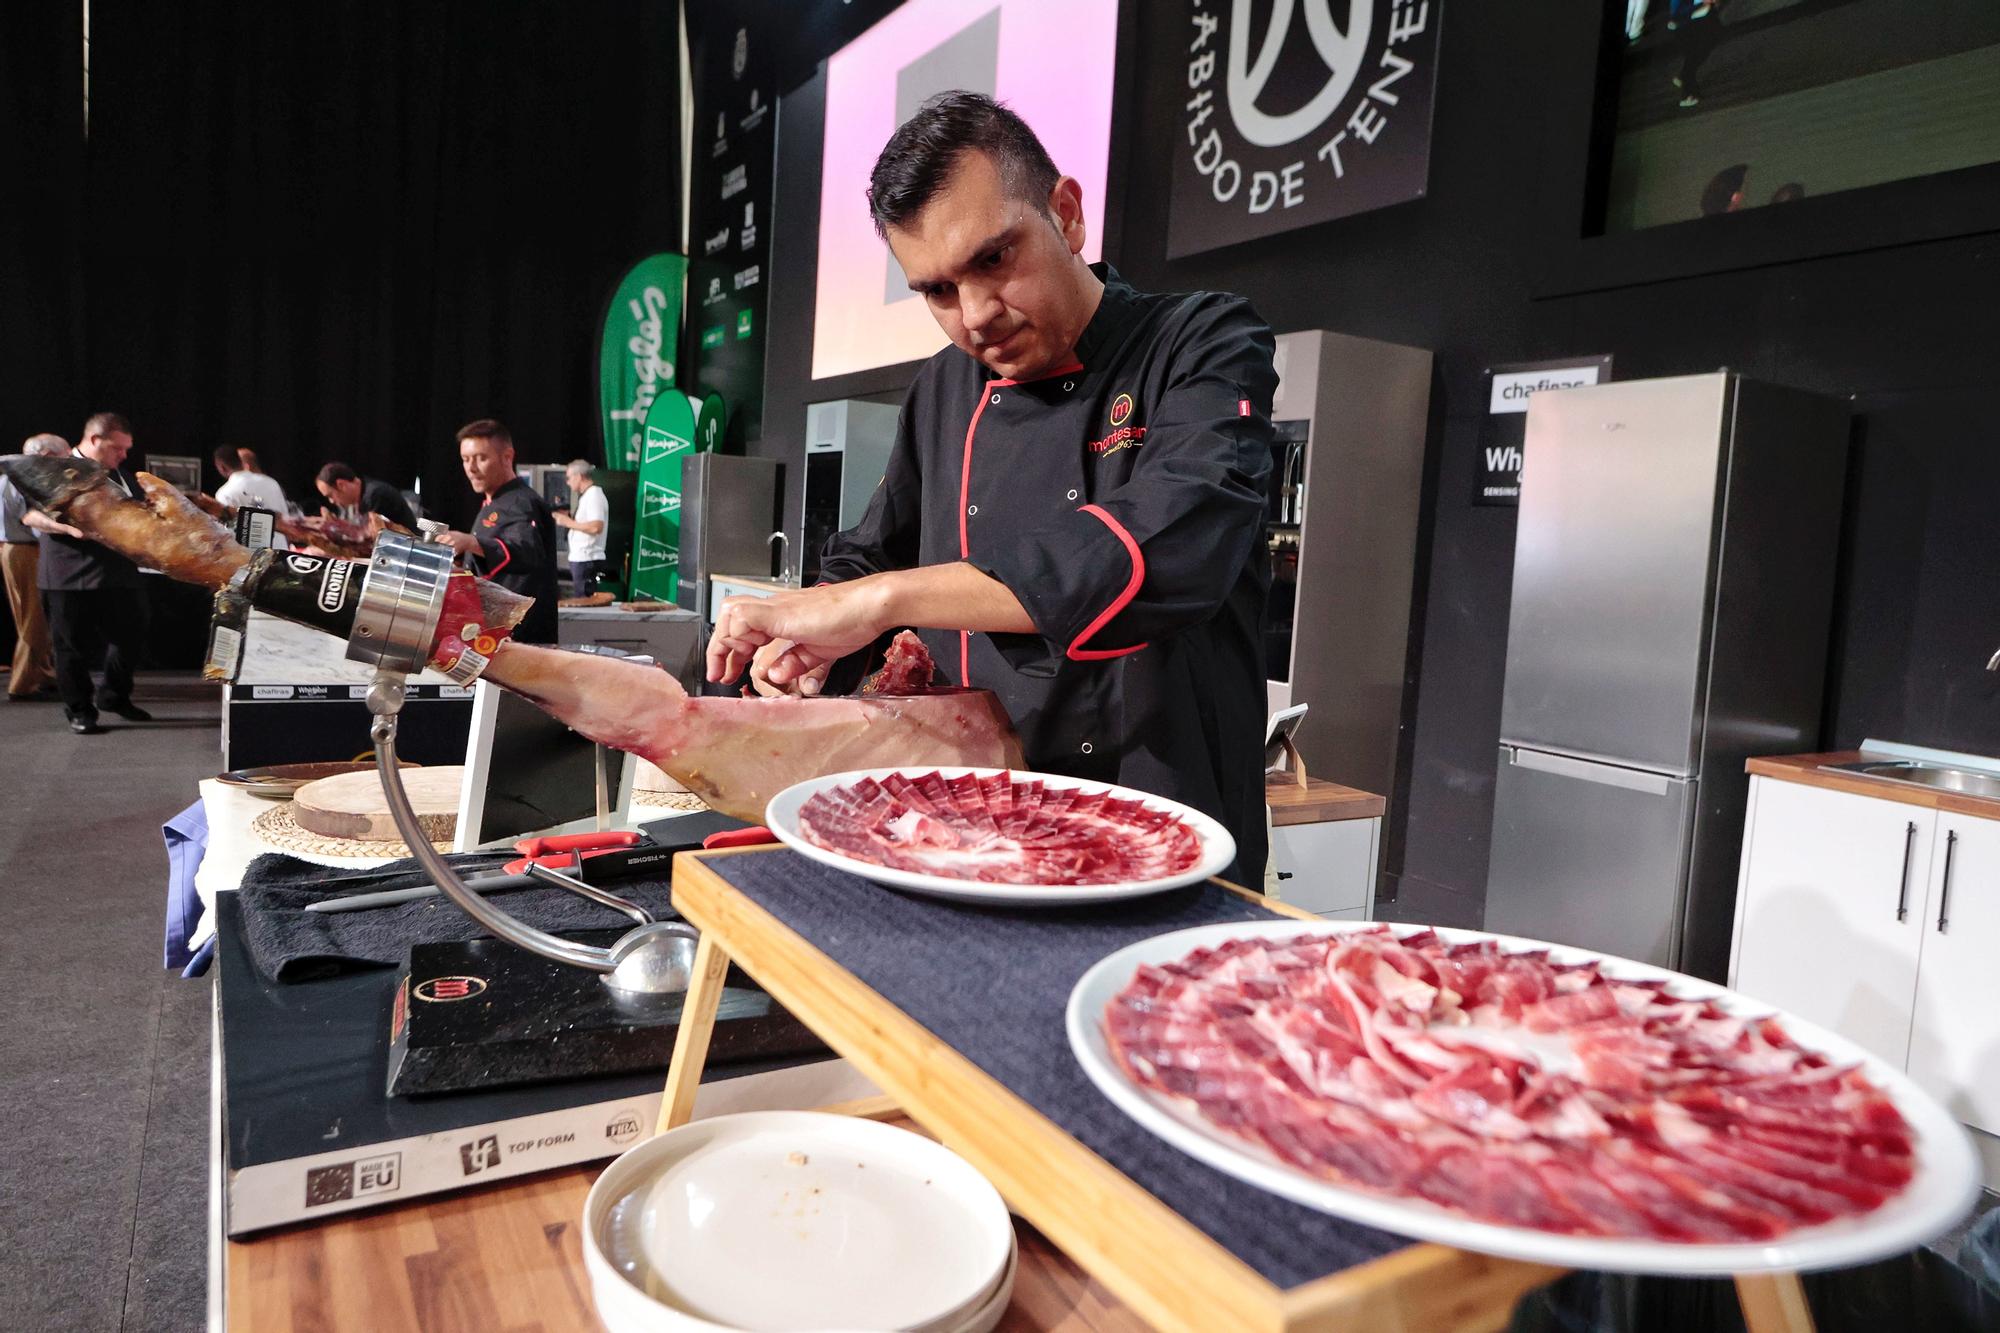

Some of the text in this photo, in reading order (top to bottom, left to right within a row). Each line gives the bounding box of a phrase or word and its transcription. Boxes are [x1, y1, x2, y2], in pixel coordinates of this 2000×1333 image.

[1187, 0, 1429, 214] ABILDO DE TENE
[1088, 427, 1147, 452] montesan
[1486, 446, 1522, 472] Wh
[508, 1132, 576, 1154] TOP FORM
[361, 1169, 394, 1190] EU
